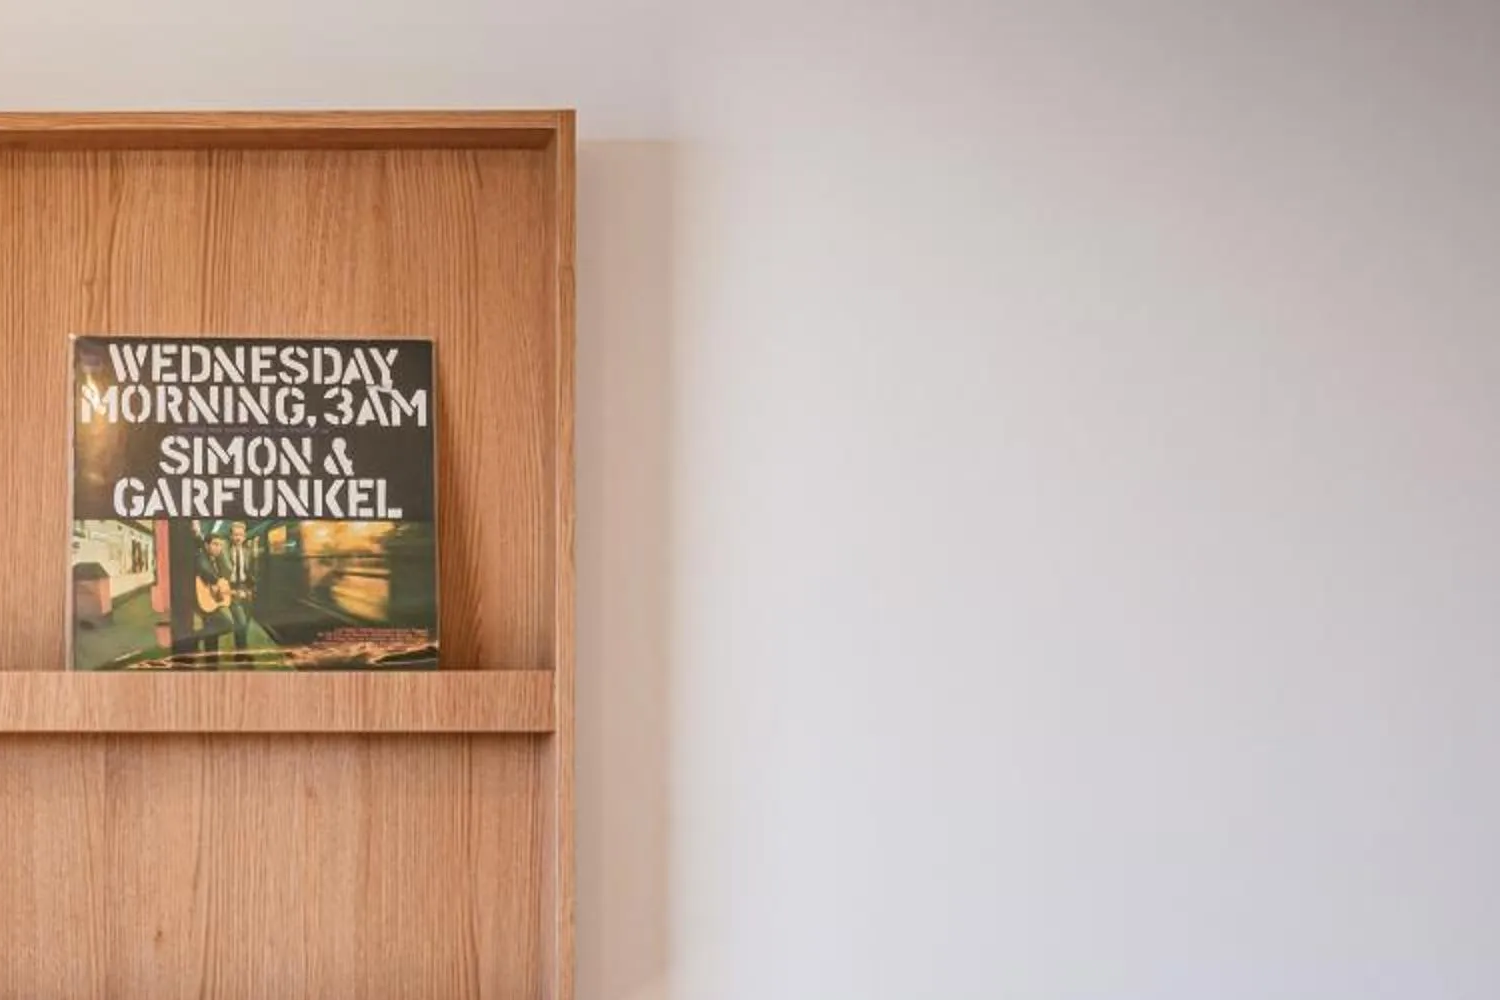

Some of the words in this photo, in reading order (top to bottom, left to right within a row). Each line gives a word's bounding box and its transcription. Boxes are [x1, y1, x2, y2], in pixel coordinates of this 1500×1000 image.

[108, 343, 399, 390] WEDNESDAY
[81, 384, 317, 428] MORNING,
[323, 386, 428, 427] 3AM
[159, 436, 313, 476] SIMON
[323, 437, 355, 477] &
[113, 477, 403, 518] GARFUNKEL
